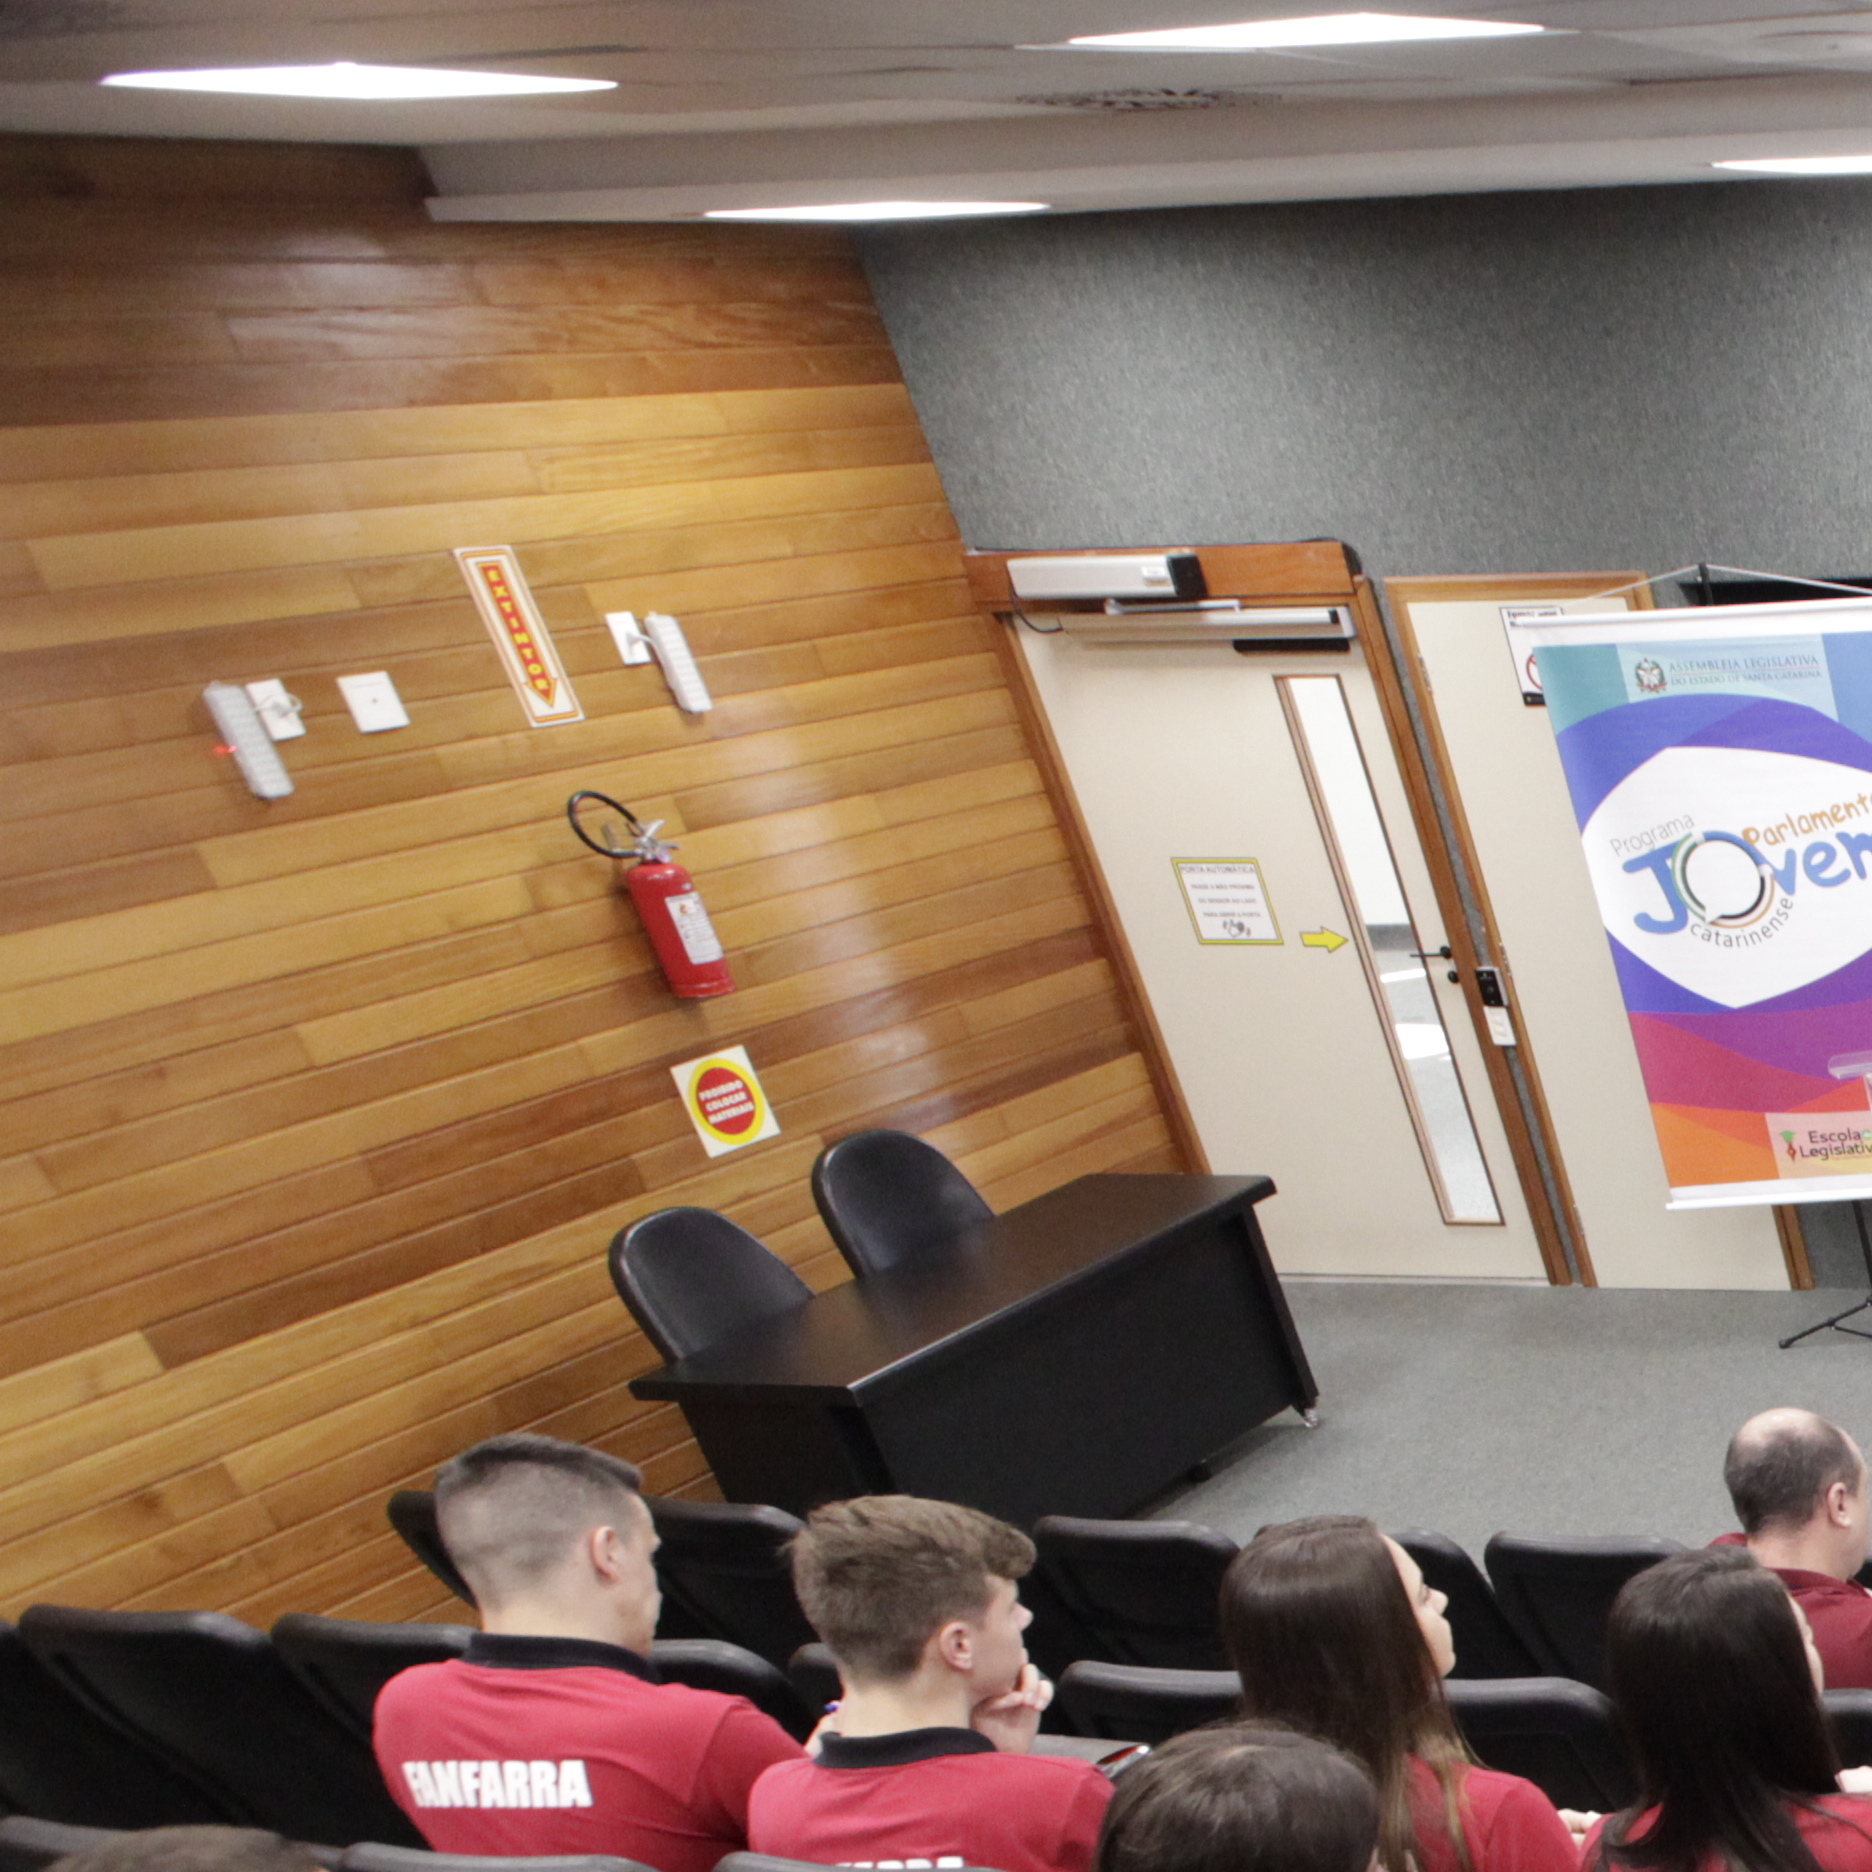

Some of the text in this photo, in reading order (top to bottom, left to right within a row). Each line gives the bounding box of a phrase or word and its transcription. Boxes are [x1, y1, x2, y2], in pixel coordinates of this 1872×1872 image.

[486, 568, 549, 690] EXTINTOR
[1669, 654, 1819, 673] ASSEMBLEIA LEGISLATIVA
[1610, 813, 1695, 857] Programa
[1690, 896, 1794, 949] catarinense
[698, 1079, 745, 1102] PROIBIDO
[705, 1091, 748, 1112] COLOCAR
[708, 1101, 756, 1125] MATERIAIS
[1808, 1127, 1861, 1143] Escola
[402, 1759, 594, 1808] FANFARRA
